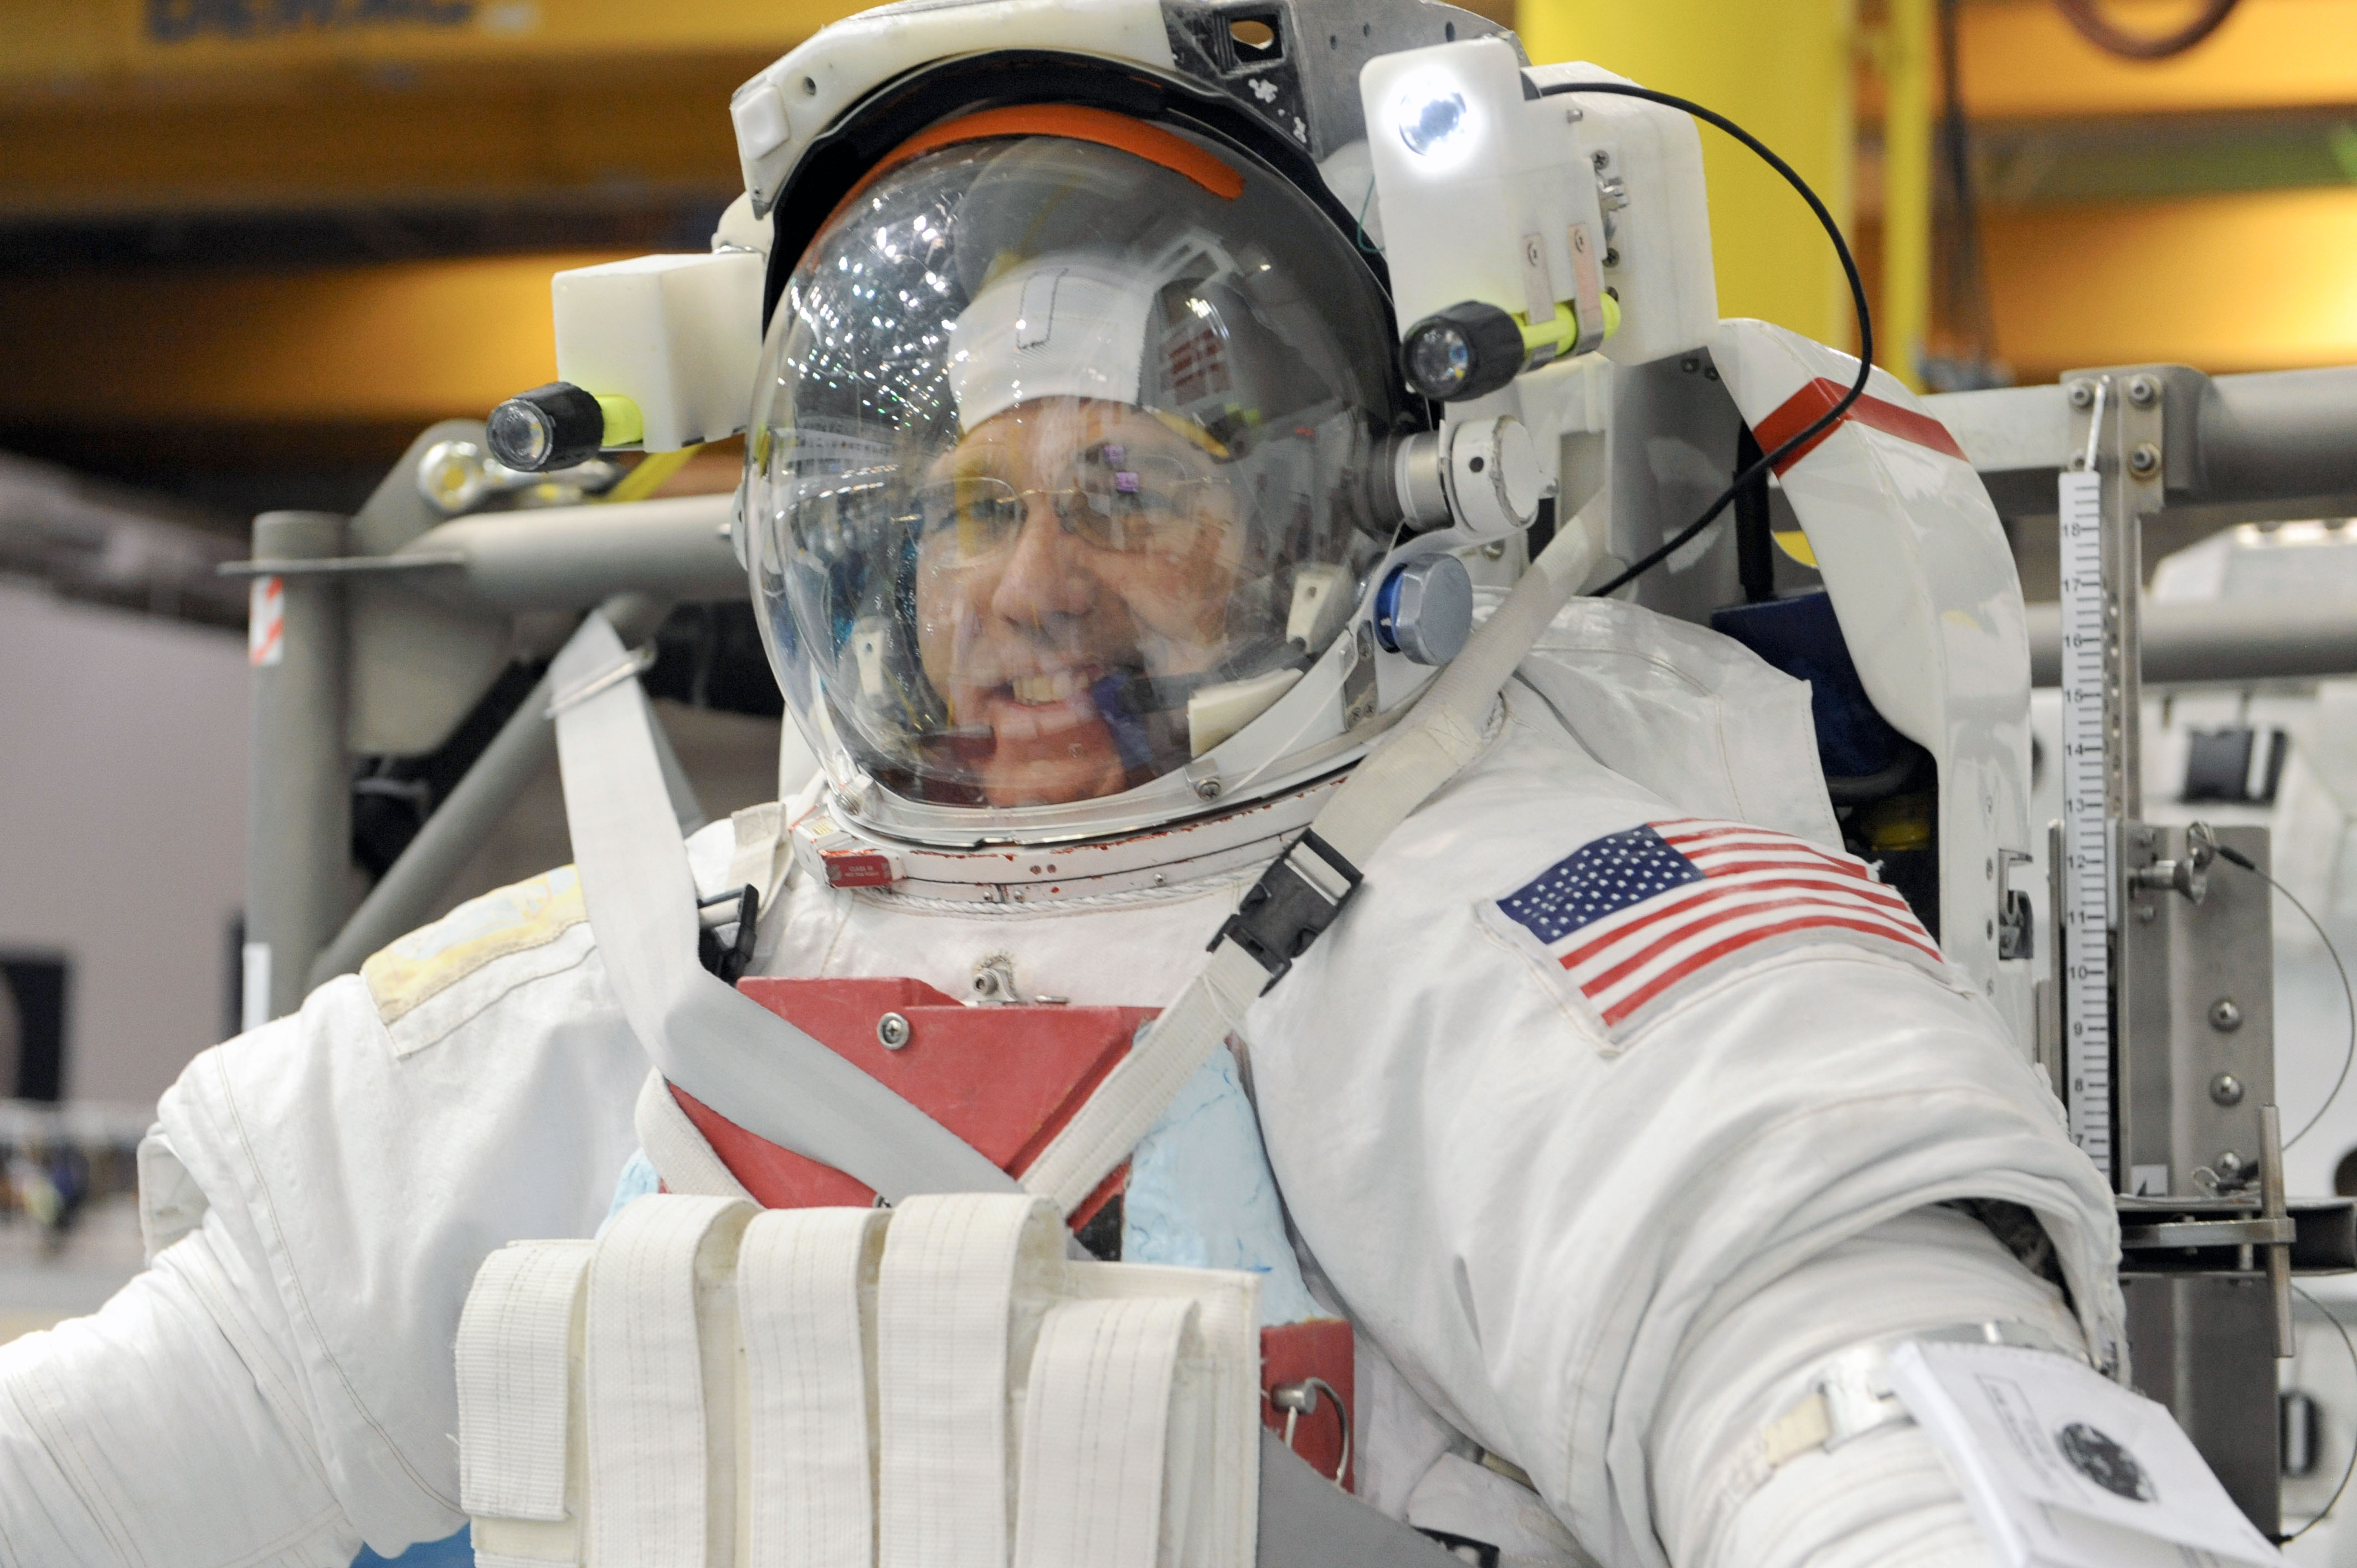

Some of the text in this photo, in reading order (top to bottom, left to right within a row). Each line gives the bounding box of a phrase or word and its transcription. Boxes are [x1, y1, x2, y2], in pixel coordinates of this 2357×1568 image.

[2063, 522, 2081, 537] 18
[2064, 578, 2081, 592] 17
[2065, 633, 2082, 647] 16
[2066, 688, 2082, 703] 15
[2067, 743, 2083, 756] 14
[2067, 799, 2085, 812] 13
[2067, 854, 2085, 869] 12
[2069, 911, 2085, 924] 11
[2070, 965, 2087, 979] 10
[2074, 1022, 2082, 1036] 9
[2075, 1078, 2083, 1091] 8
[2076, 1134, 2083, 1147] 7
